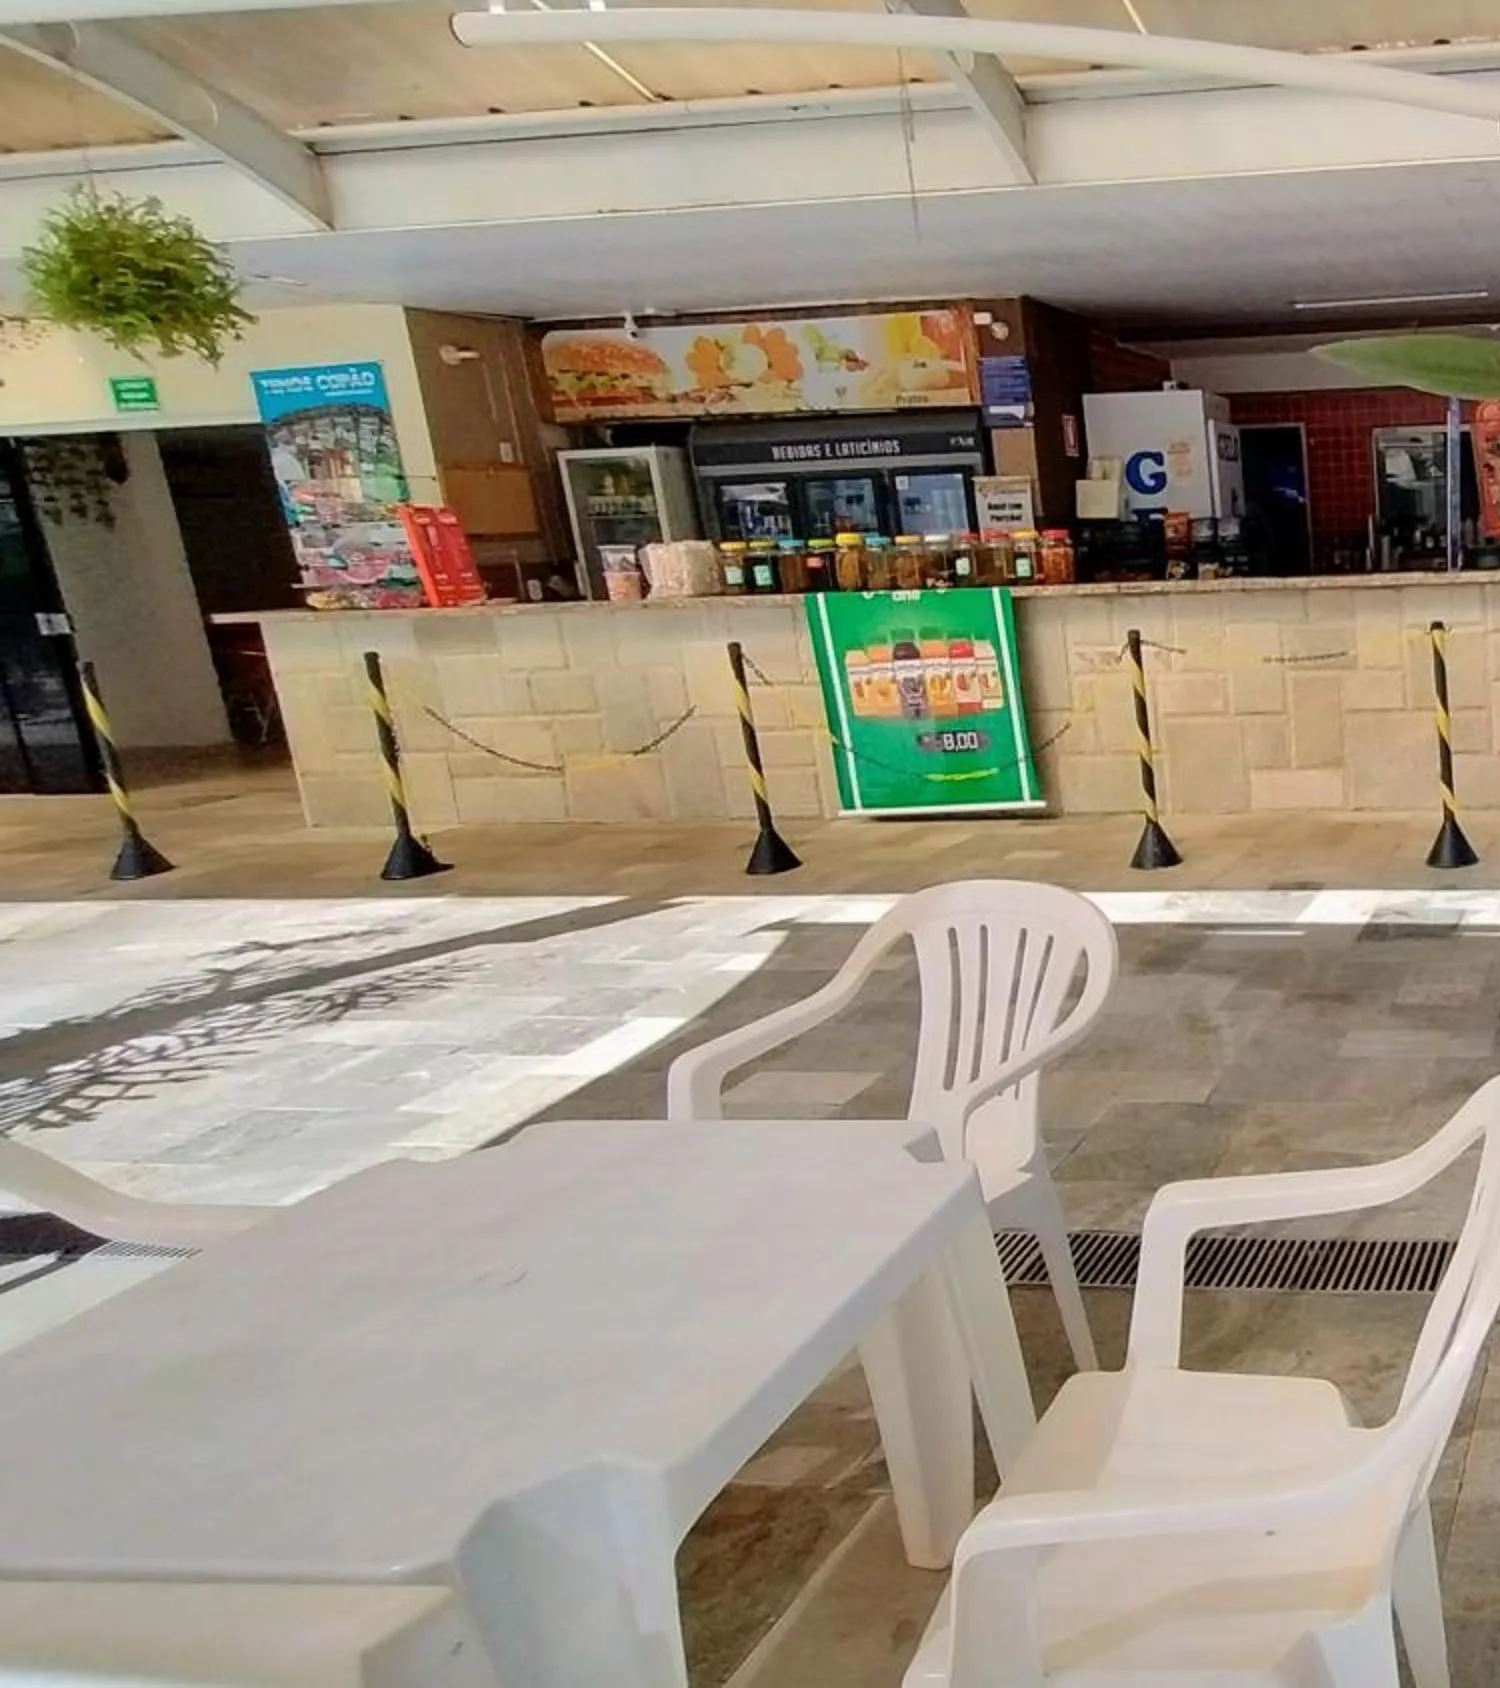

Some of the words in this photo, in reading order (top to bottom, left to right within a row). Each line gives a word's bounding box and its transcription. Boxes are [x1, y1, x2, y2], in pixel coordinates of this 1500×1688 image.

[316, 367, 376, 390] COPÃO
[771, 444, 821, 460] BEBIDAS
[825, 443, 833, 457] E
[835, 438, 900, 457] LATICÍNIOS
[1125, 450, 1168, 495] G
[943, 731, 979, 752] 8,00
